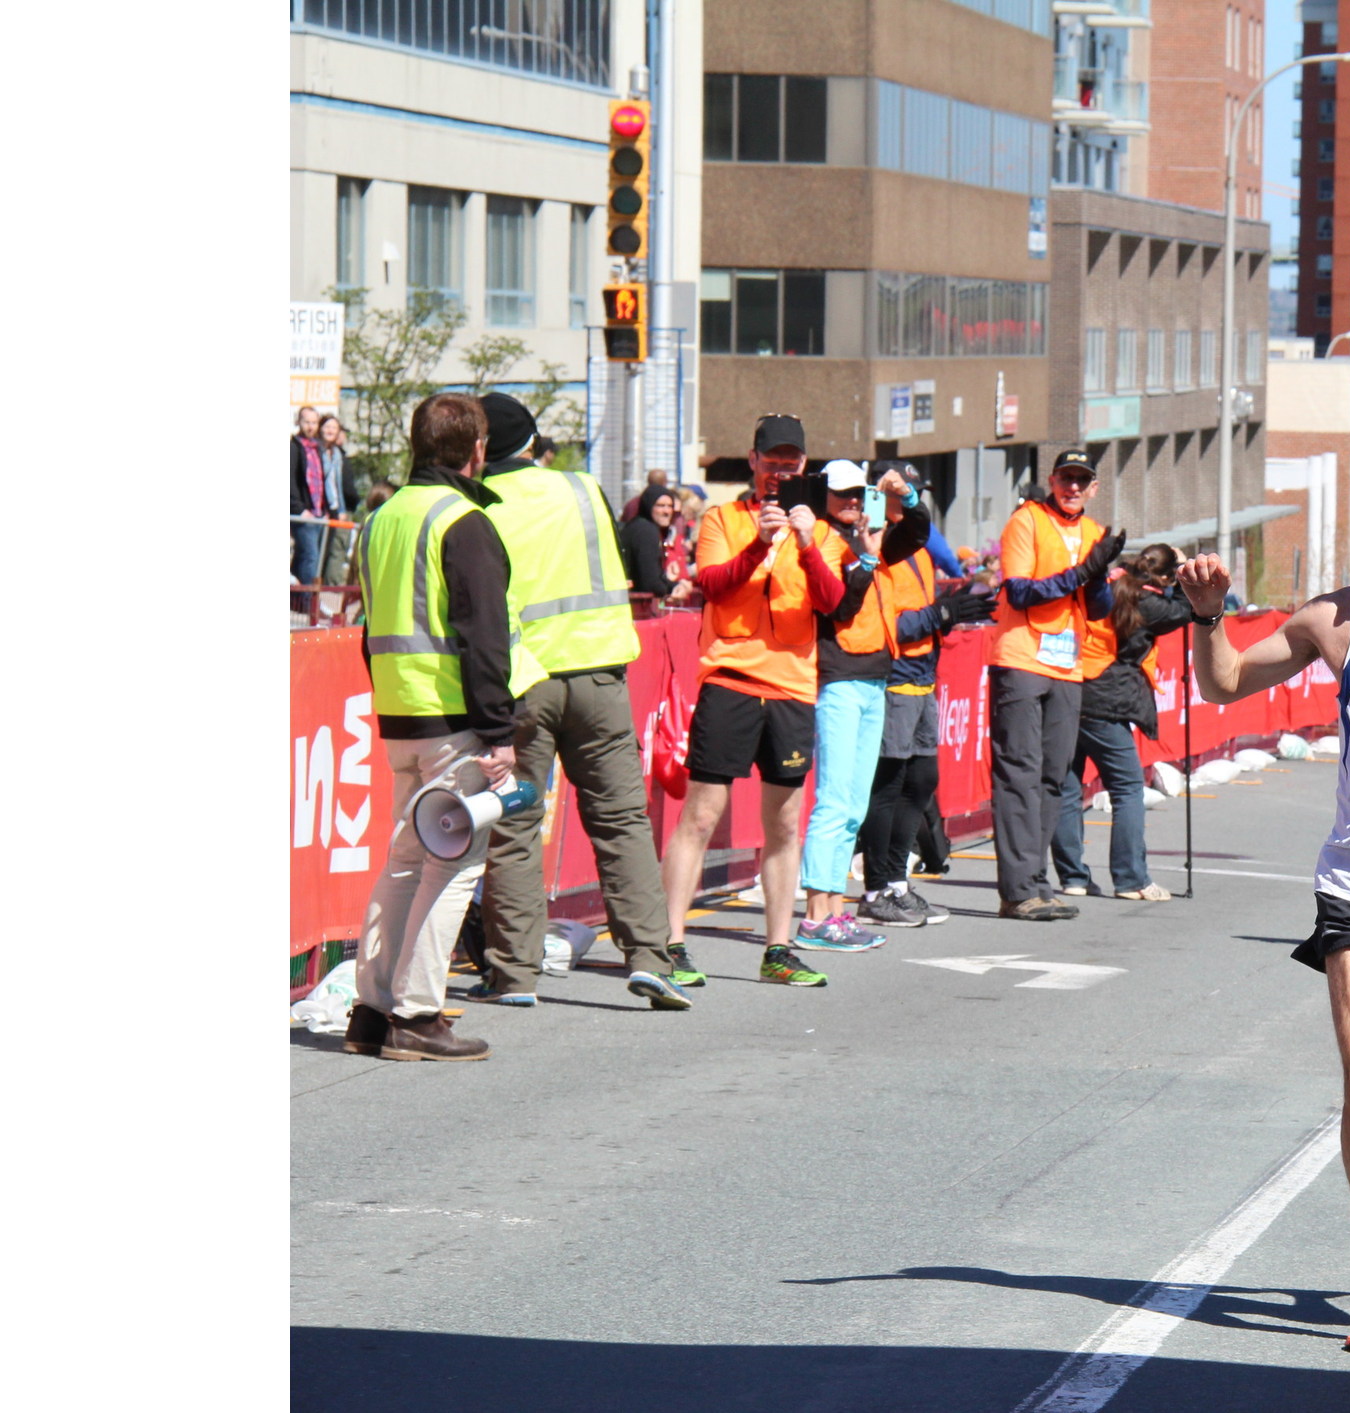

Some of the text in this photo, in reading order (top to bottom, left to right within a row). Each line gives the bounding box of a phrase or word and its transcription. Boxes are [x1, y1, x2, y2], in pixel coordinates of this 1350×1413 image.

[329, 691, 373, 874] KM
[937, 684, 971, 762] llenge
[293, 725, 335, 850] 5
